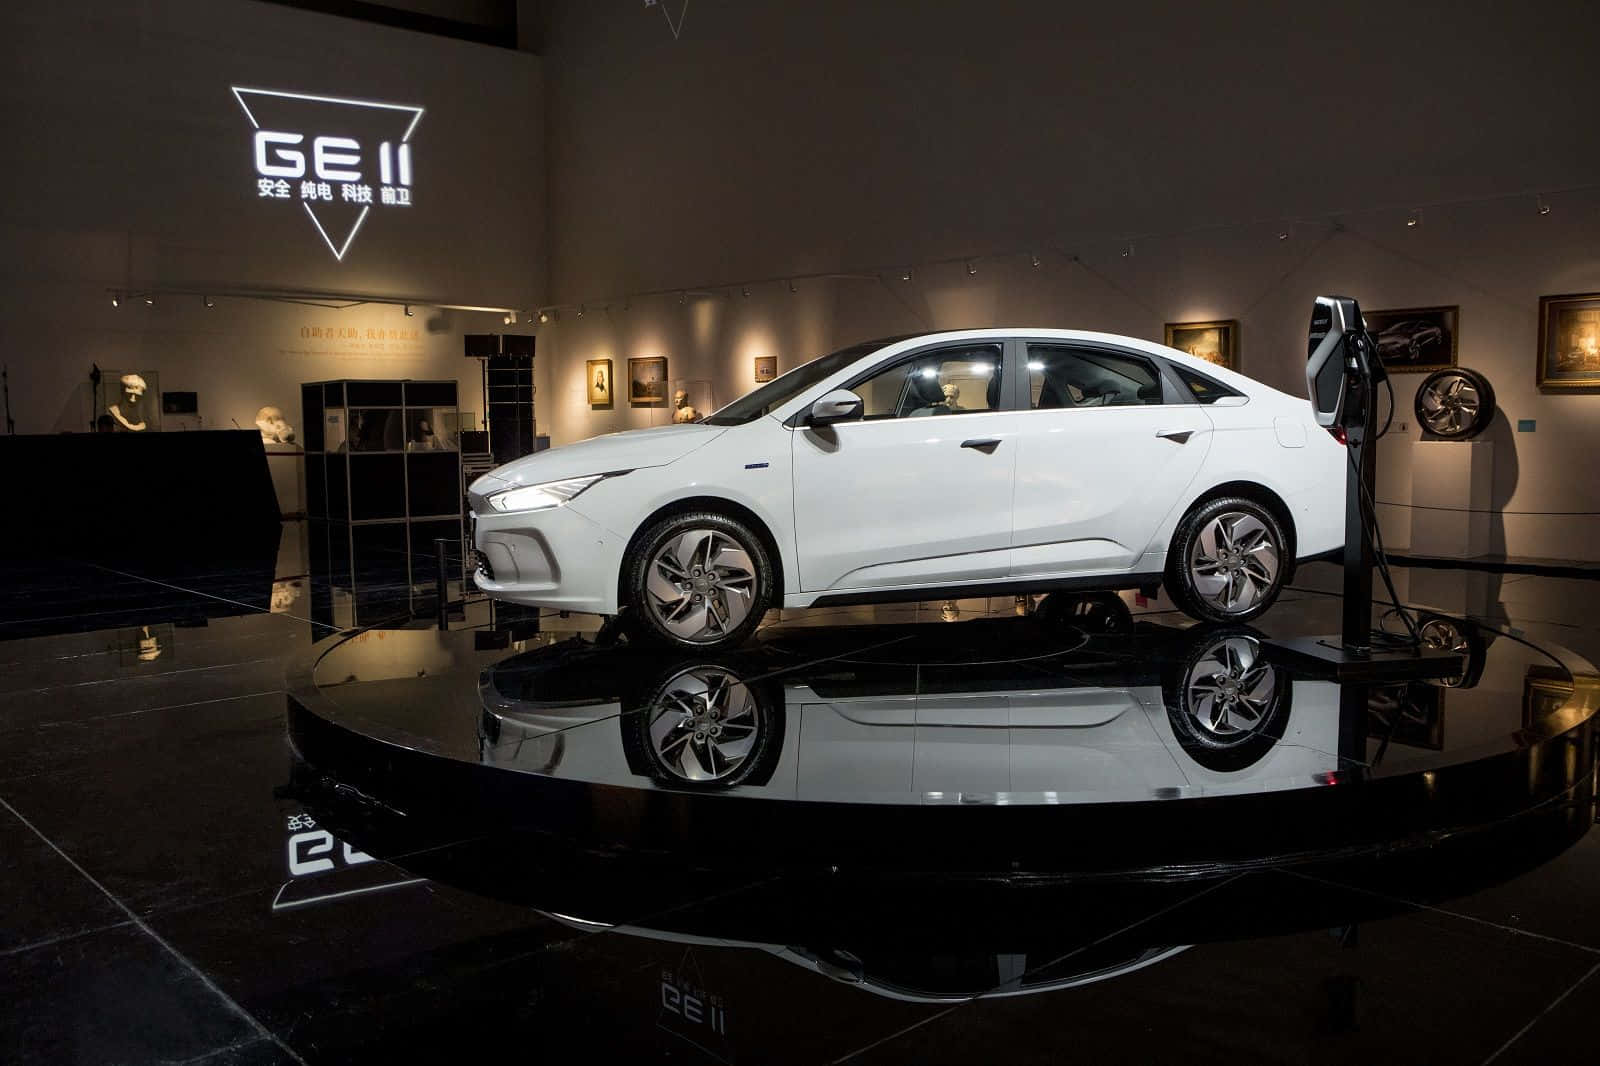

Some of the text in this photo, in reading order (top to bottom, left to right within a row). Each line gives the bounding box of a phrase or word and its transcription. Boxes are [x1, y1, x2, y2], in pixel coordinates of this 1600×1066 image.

[255, 131, 362, 182] GE
[257, 178, 412, 206] 安全 纯电 科技 前卫
